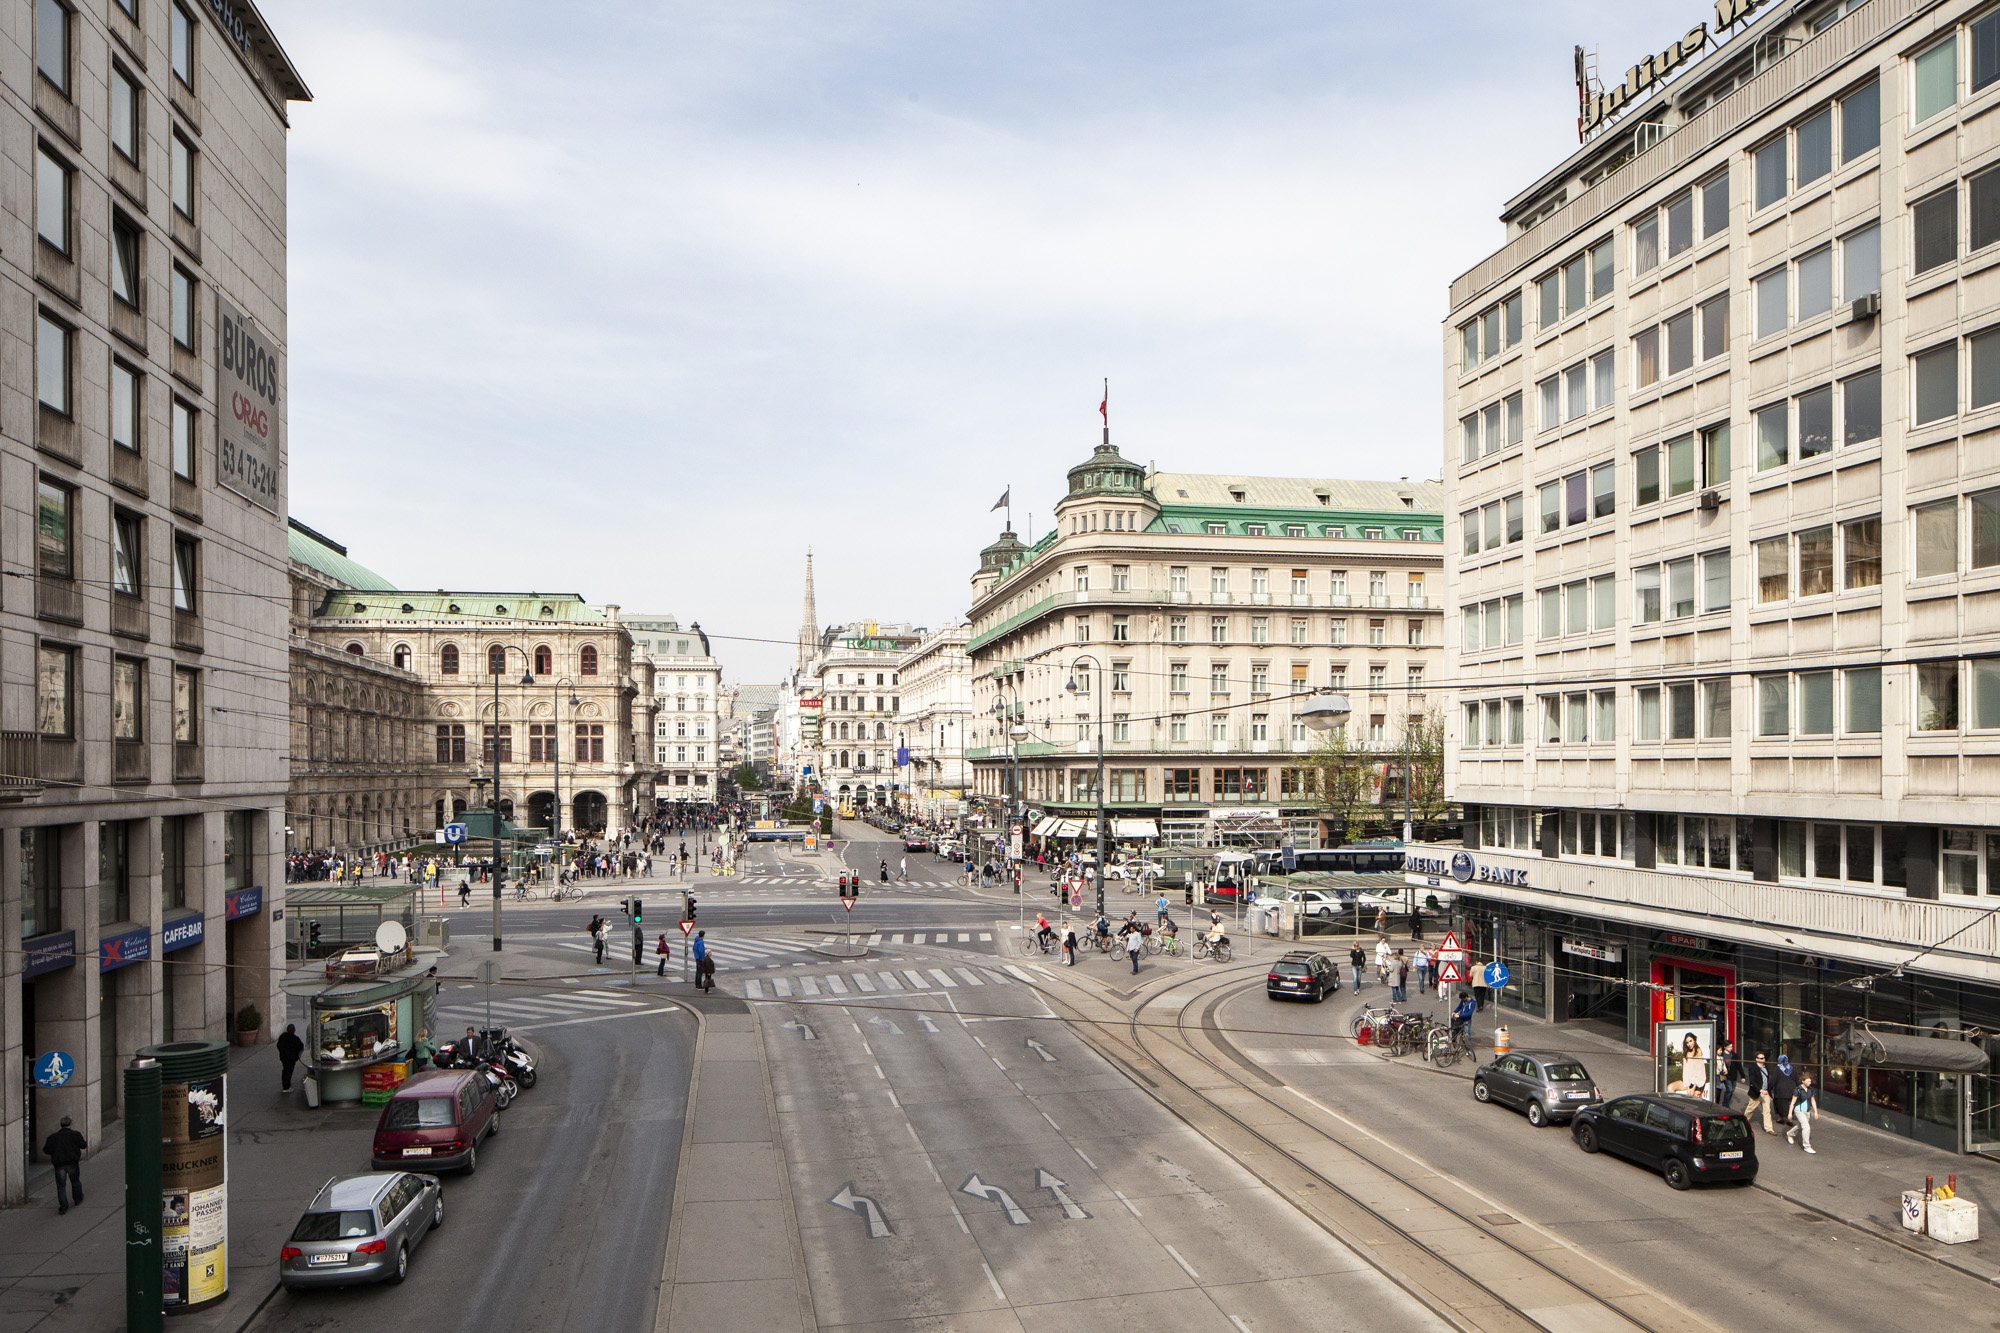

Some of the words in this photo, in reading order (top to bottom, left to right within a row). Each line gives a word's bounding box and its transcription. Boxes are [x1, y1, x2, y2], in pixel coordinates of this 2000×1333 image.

[1580, 22, 1707, 133] Julius
[223, 314, 276, 406] BÜROS
[223, 438, 235, 475] 53
[237, 449, 244, 481] 4
[246, 453, 277, 500] 73-214
[846, 638, 897, 650] ROLEX
[447, 828, 461, 842] U
[1406, 856, 1449, 875] MEINL
[1479, 865, 1529, 886] BANK
[164, 922, 202, 944] CAFFÈ-BAR
[1671, 935, 1696, 946] SPAR
[1570, 945, 1591, 955] Karlsplatz
[163, 1155, 218, 1172] BRUCKNER
[196, 1205, 222, 1217] PASSION
